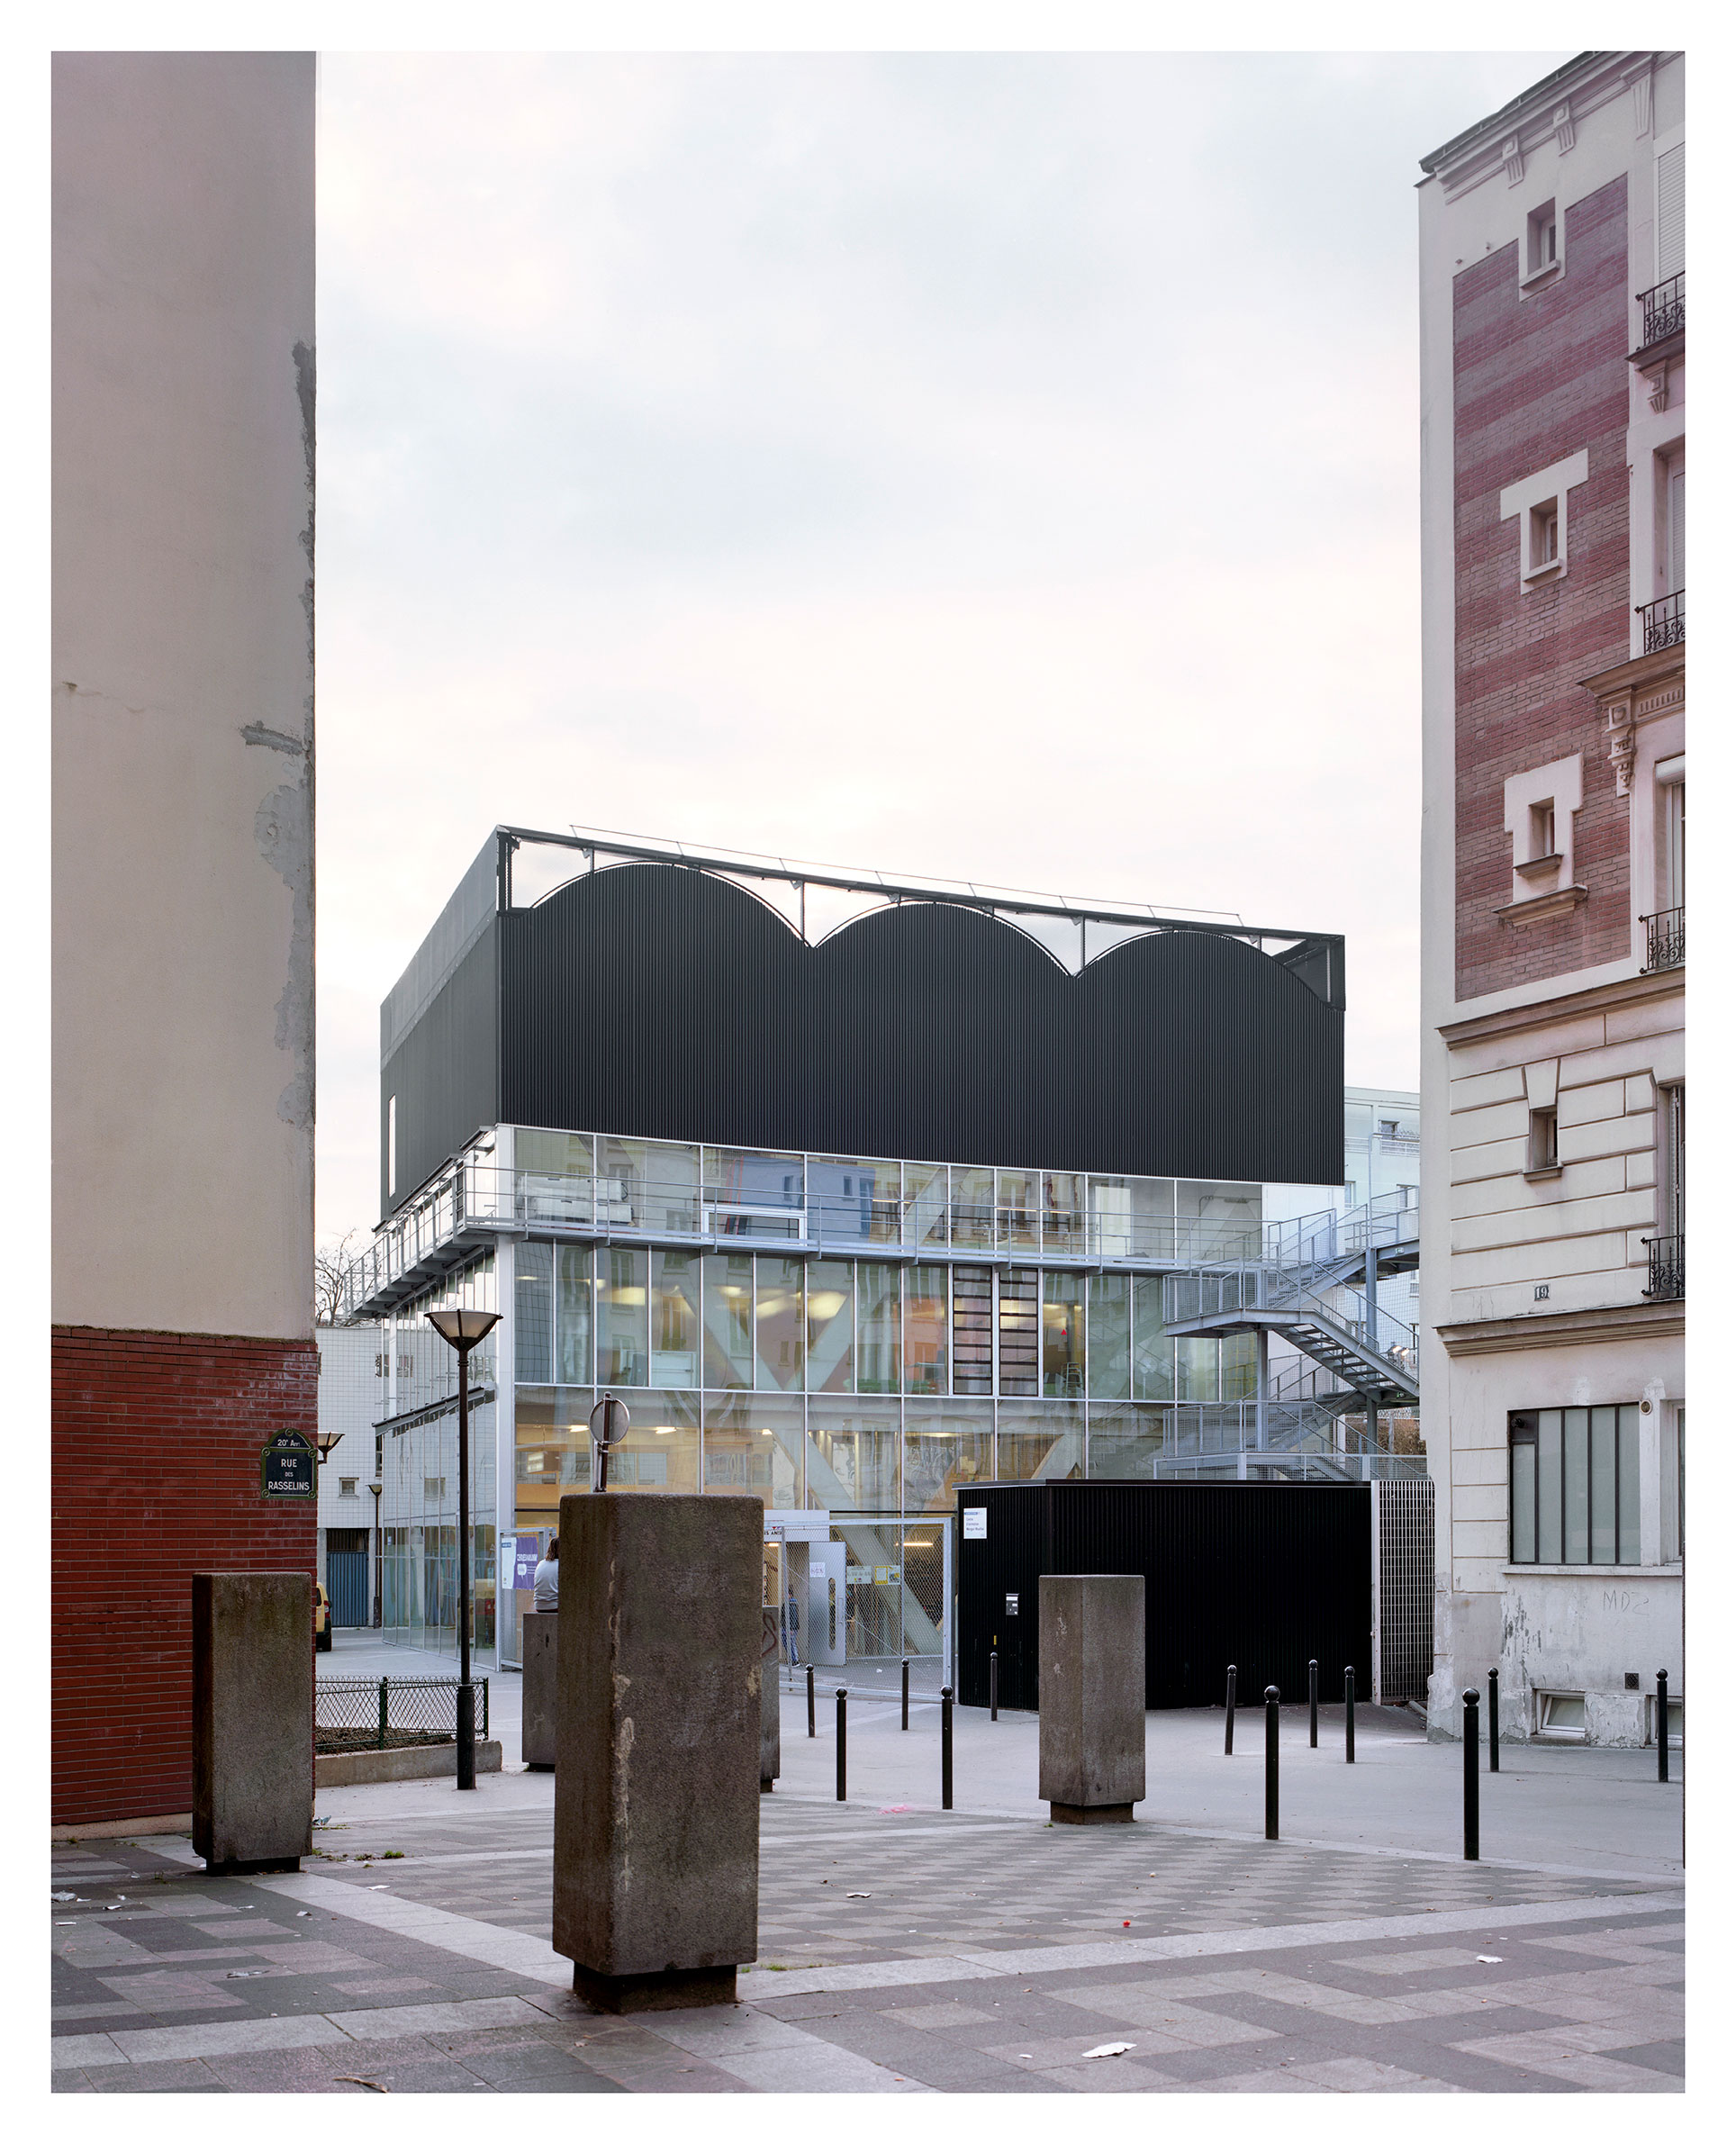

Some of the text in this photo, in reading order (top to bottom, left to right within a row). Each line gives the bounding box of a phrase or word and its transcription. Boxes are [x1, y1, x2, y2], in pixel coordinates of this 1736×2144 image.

[1536, 1286, 1548, 1298] 19
[281, 1458, 297, 1468] RUE
[267, 1480, 310, 1491] RASSELINS
